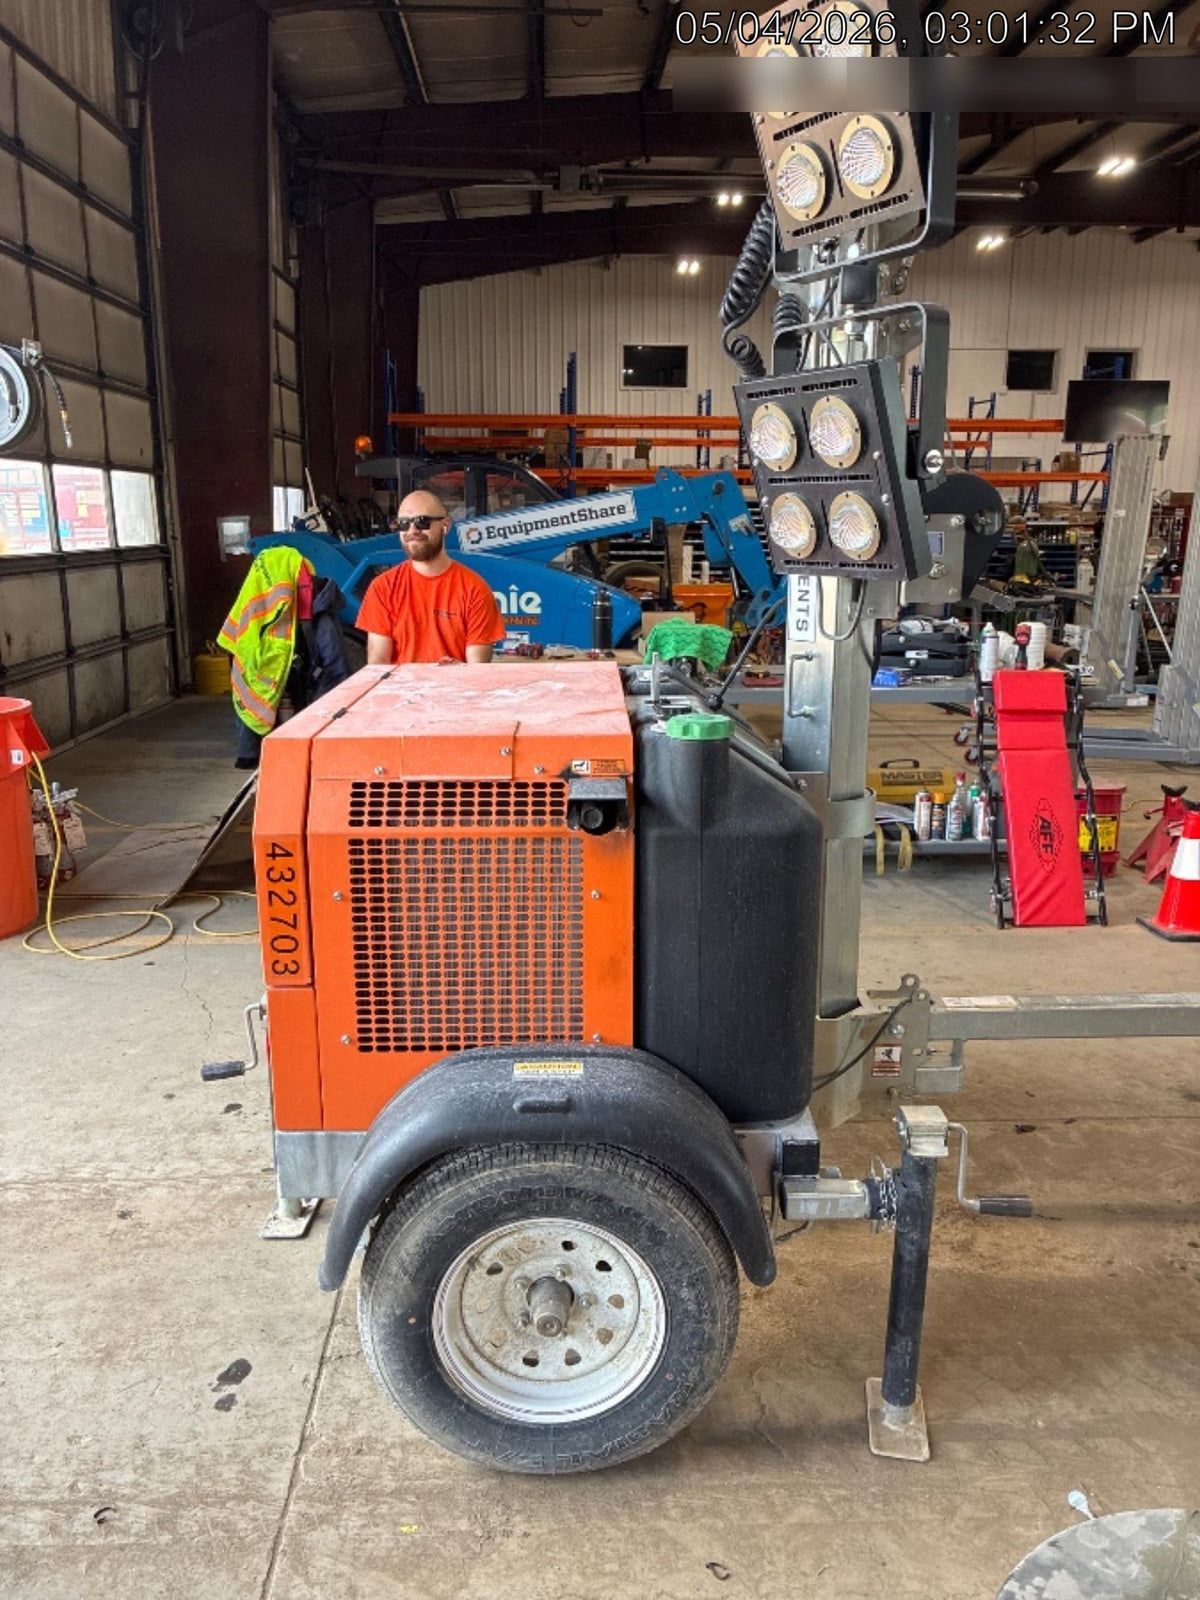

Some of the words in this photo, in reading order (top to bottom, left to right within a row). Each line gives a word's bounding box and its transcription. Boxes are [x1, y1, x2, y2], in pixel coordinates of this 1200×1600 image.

[485, 502, 628, 541] EquipmentShare
[492, 584, 542, 614] nie
[265, 841, 301, 976] 432703
